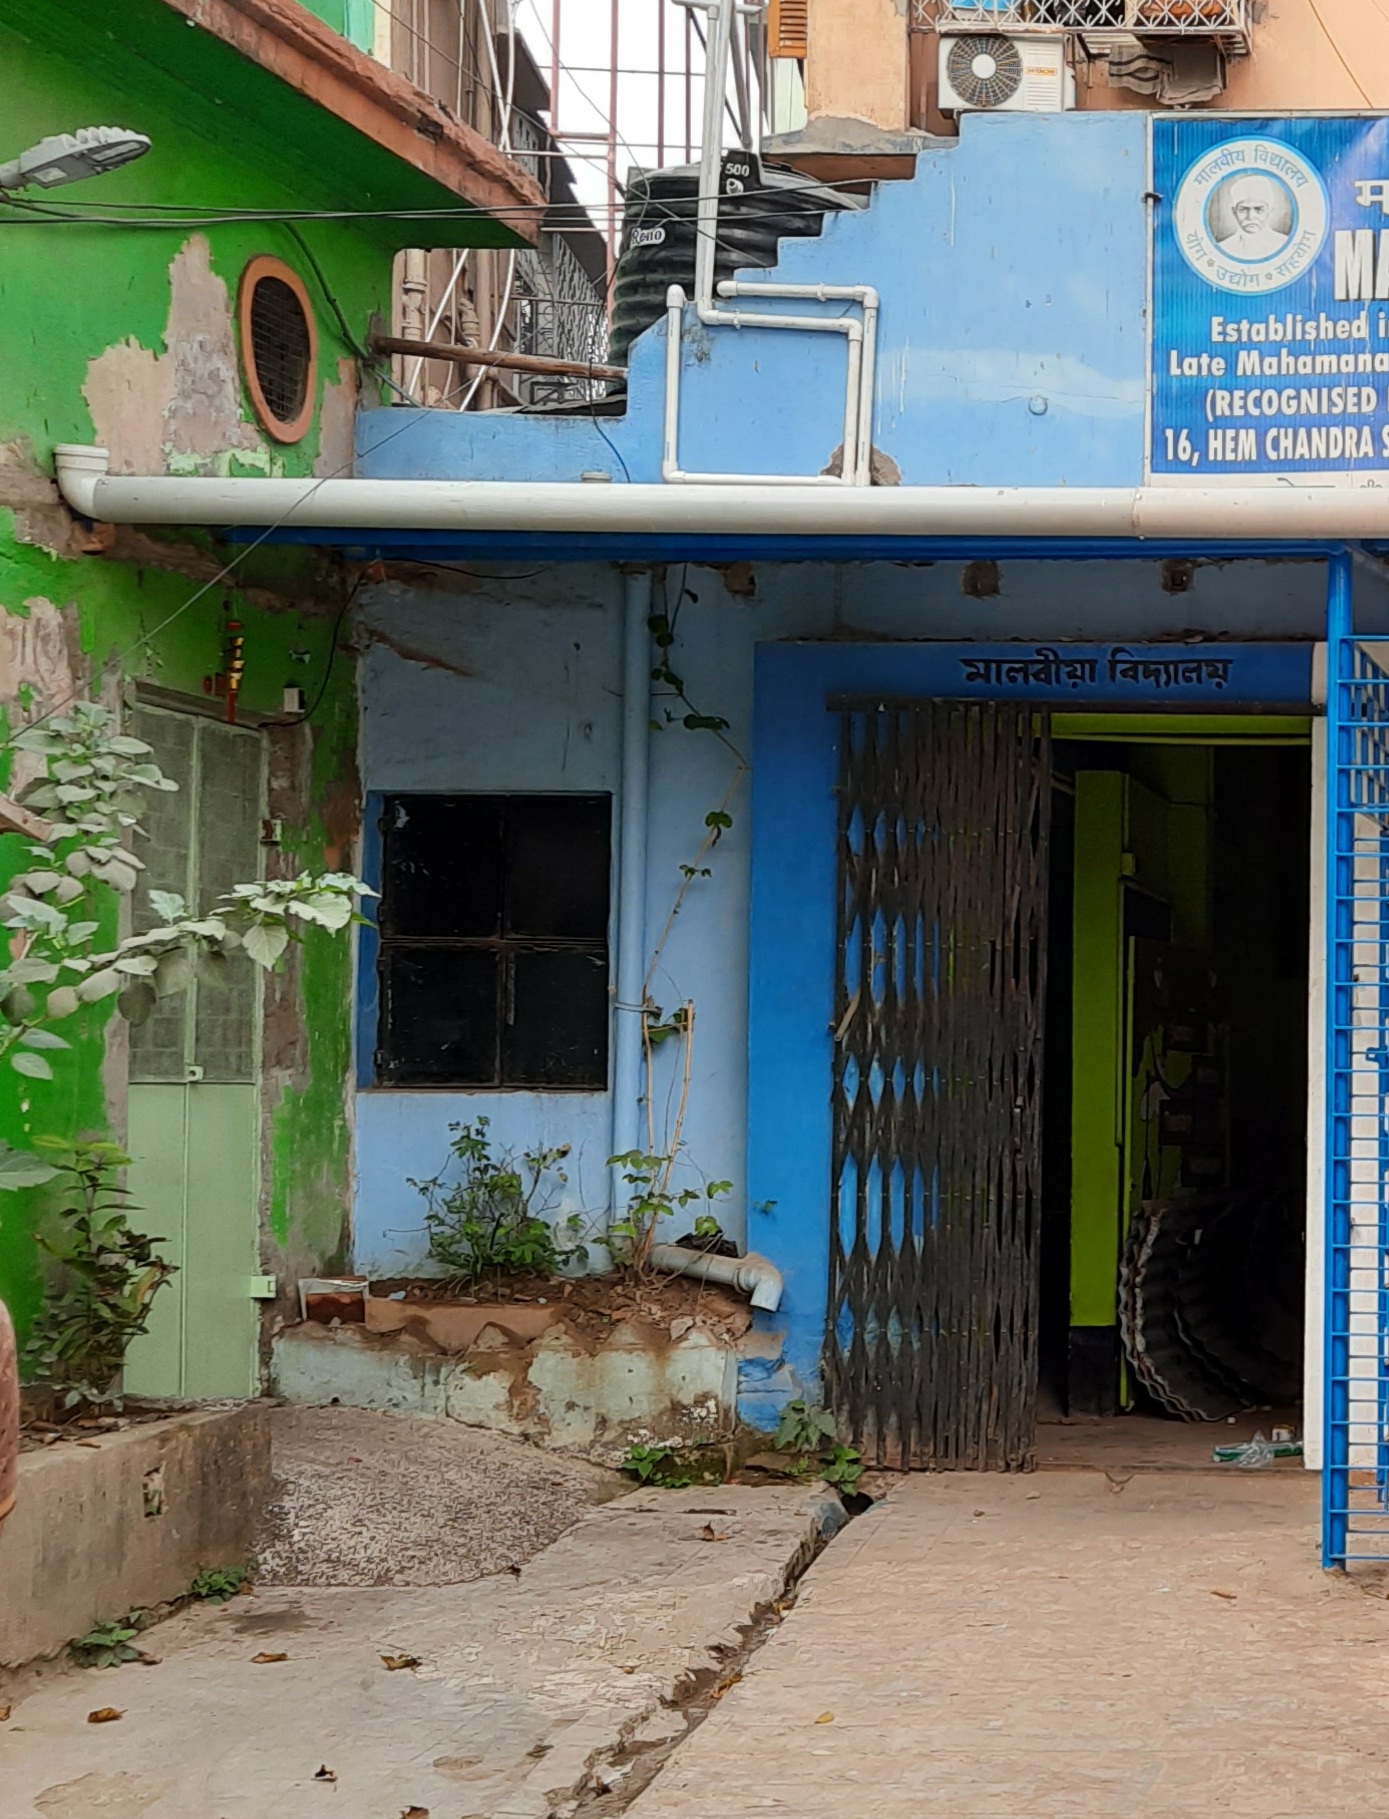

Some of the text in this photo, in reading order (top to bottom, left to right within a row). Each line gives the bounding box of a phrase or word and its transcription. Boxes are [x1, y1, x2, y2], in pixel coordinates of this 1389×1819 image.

[725, 163, 750, 177] 500
[1193, 144, 1309, 188] मालवीय विद्यालय
[1186, 229, 1316, 288] योग उद्योग सहयोग
[1211, 310, 1369, 343] Established
[1170, 350, 1226, 376] Late
[1236, 348, 1389, 376] Mahamana
[1206, 387, 1377, 422] (RECOGNISED
[1165, 428, 1199, 466] 16,
[1208, 428, 1257, 461] HEM
[1265, 425, 1374, 461] CHANDRA
[1107, 646, 1234, 689] বিদ্যালয়
